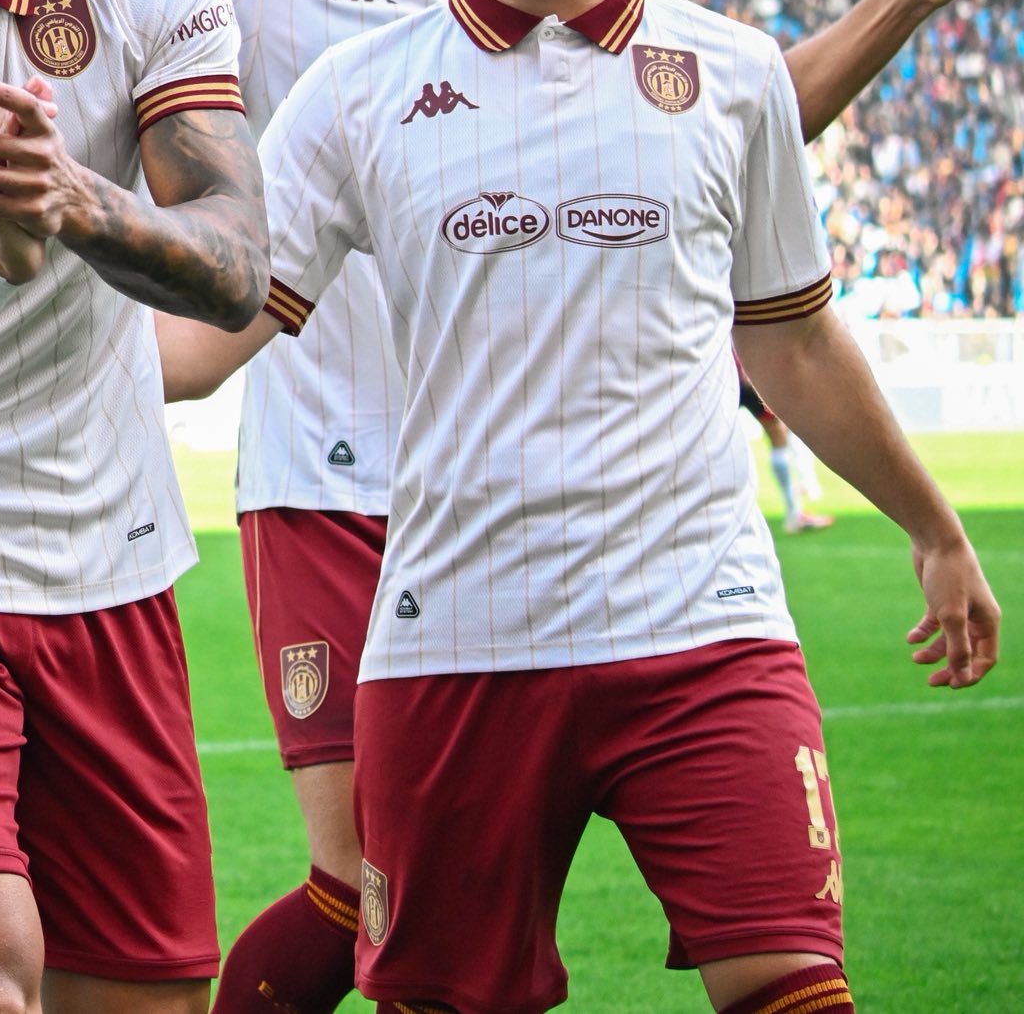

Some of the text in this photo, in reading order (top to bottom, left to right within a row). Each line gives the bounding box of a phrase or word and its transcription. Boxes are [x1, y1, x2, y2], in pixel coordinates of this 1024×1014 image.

[171, 5, 228, 45] MAGIC
[453, 210, 538, 240] délice
[719, 587, 752, 596] KOMBAT
